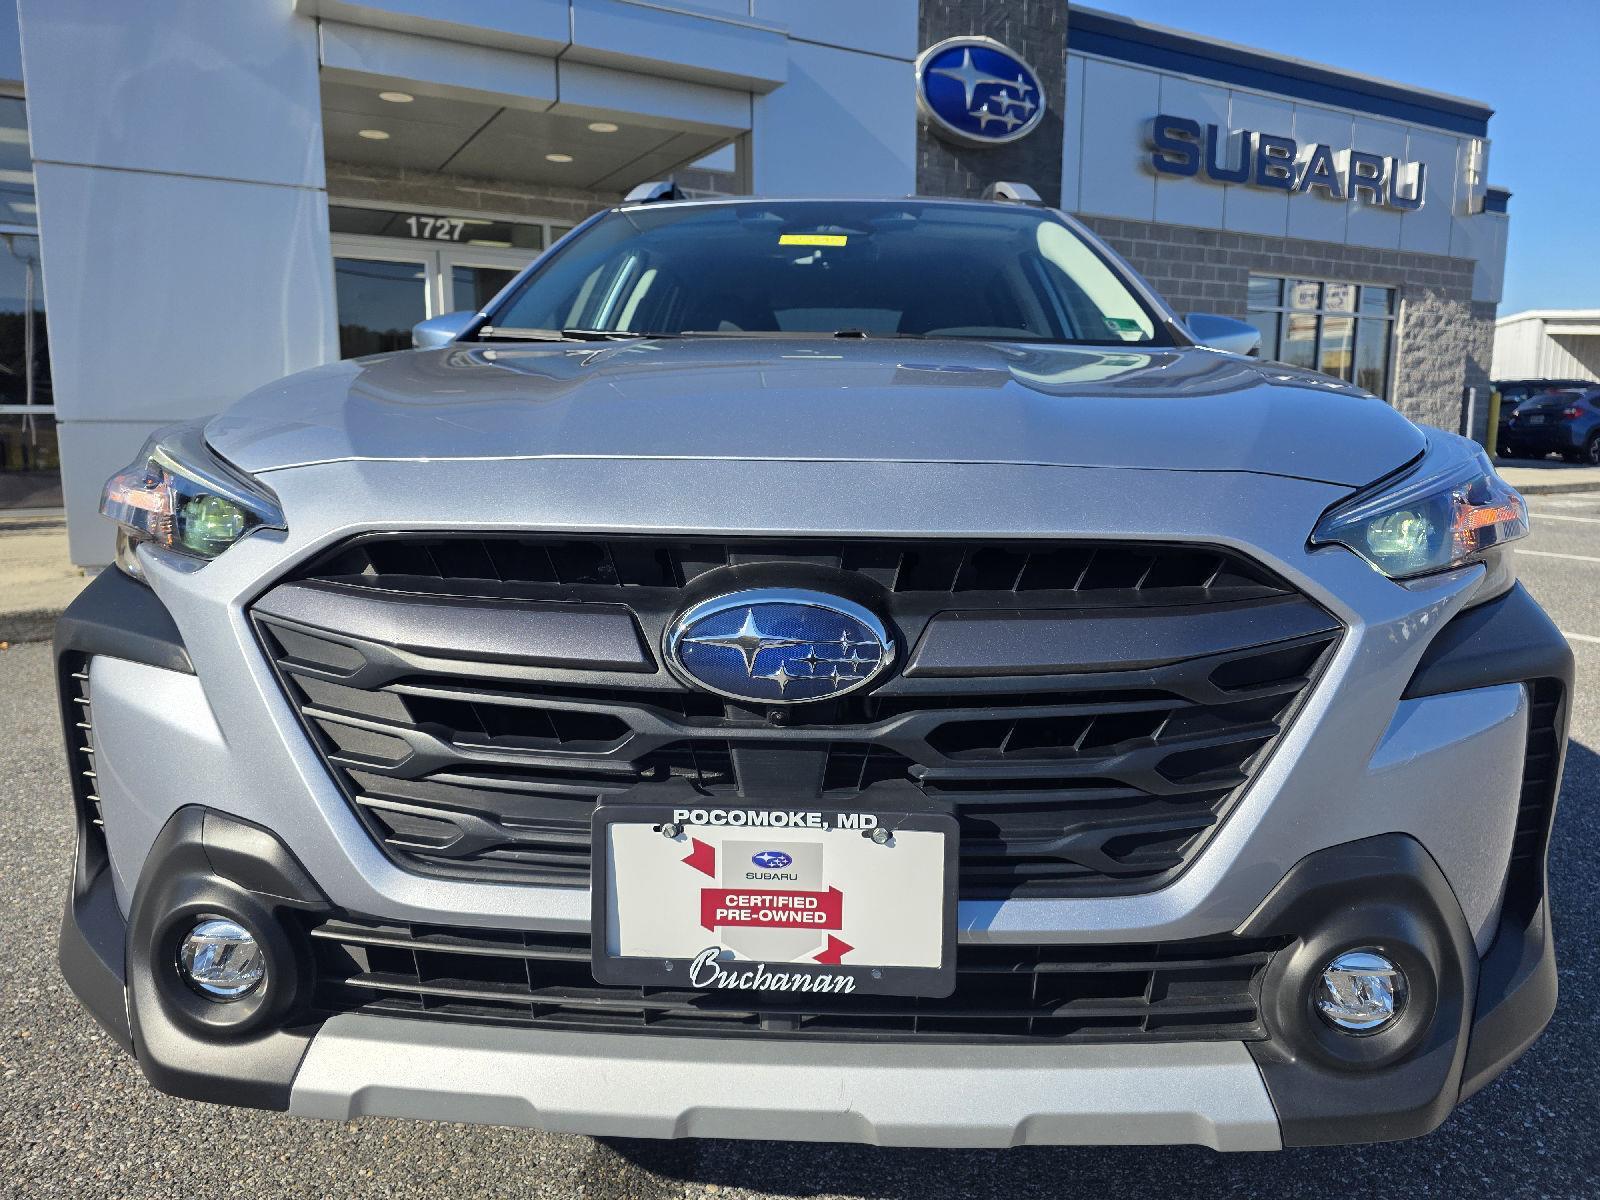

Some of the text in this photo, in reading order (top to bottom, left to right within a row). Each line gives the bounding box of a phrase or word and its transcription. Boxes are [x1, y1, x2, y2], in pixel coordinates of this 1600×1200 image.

[1152, 114, 1428, 211] SUBARU
[406, 215, 465, 240] 1727
[673, 809, 878, 830] POCOMOKE, MD
[745, 872, 798, 881] SUBARU
[725, 895, 818, 909] CERTIFIED
[716, 909, 827, 923] PRE-OWNED
[689, 948, 856, 994] Buchanan
